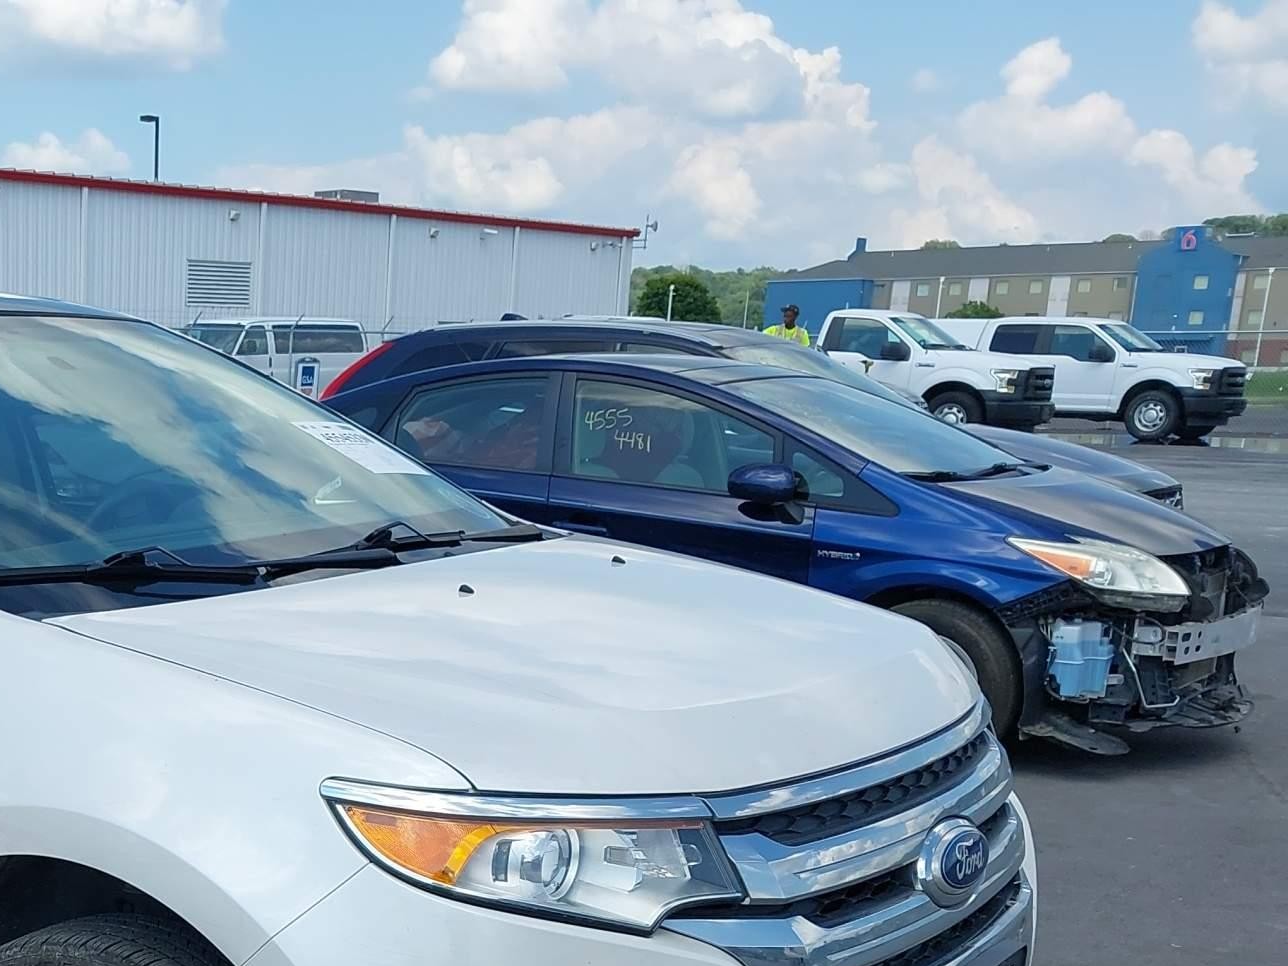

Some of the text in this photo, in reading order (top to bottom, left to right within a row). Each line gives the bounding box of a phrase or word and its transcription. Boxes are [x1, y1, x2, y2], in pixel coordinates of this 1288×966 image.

[1180, 229, 1197, 250] 6
[584, 408, 633, 431] 4555
[614, 429, 651, 453] 4481
[956, 839, 984, 880] Ford
